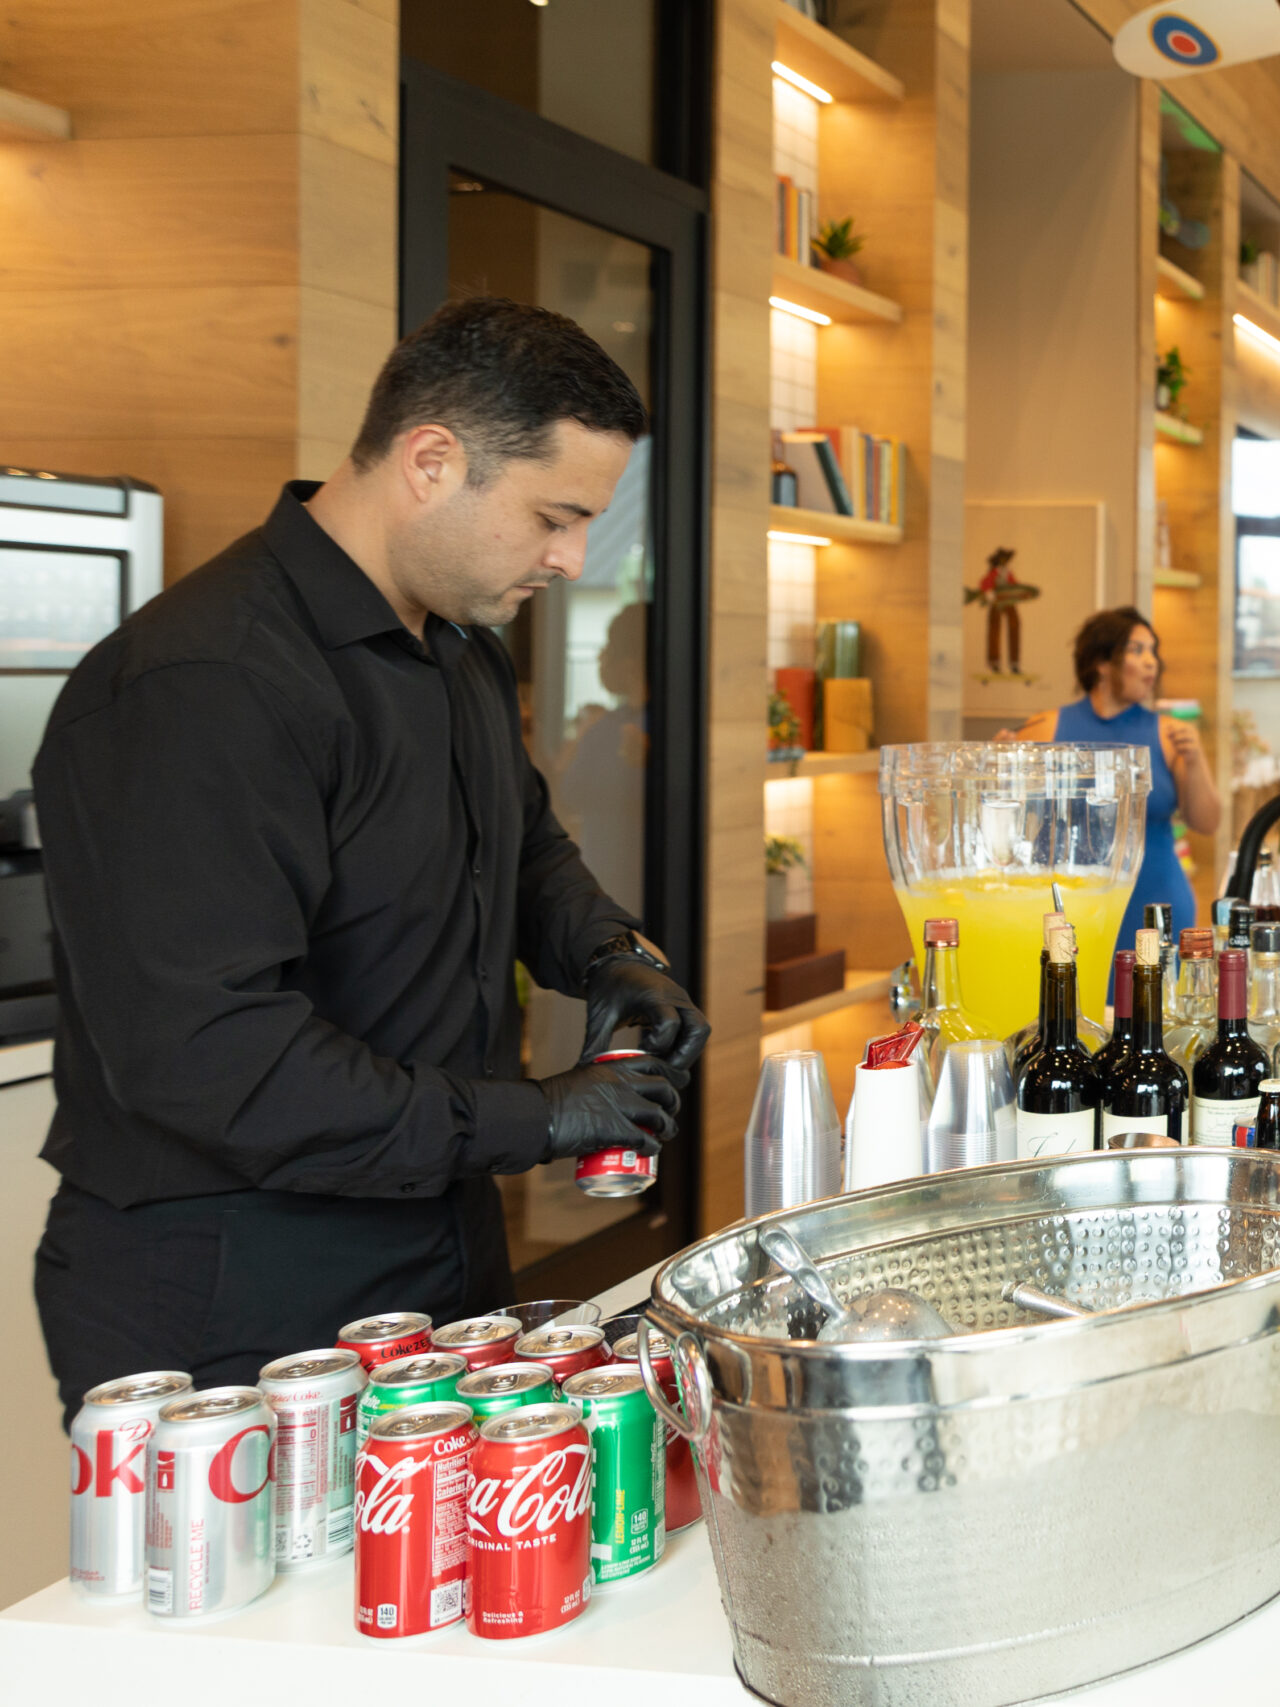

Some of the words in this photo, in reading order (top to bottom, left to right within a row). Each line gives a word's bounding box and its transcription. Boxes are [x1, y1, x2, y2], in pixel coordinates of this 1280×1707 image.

[381, 1343, 413, 1359] Coke
[434, 1436, 467, 1456] Coke
[436, 1481, 465, 1497] Calories
[634, 1511, 647, 1524] 140
[192, 1518, 205, 1546] ME
[515, 1533, 557, 1550] TASTE
[189, 1547, 203, 1611] RECYCLE
[380, 1606, 395, 1616] 140
[482, 1610, 516, 1619] Delicious
[482, 1616, 524, 1625] Refreshing
